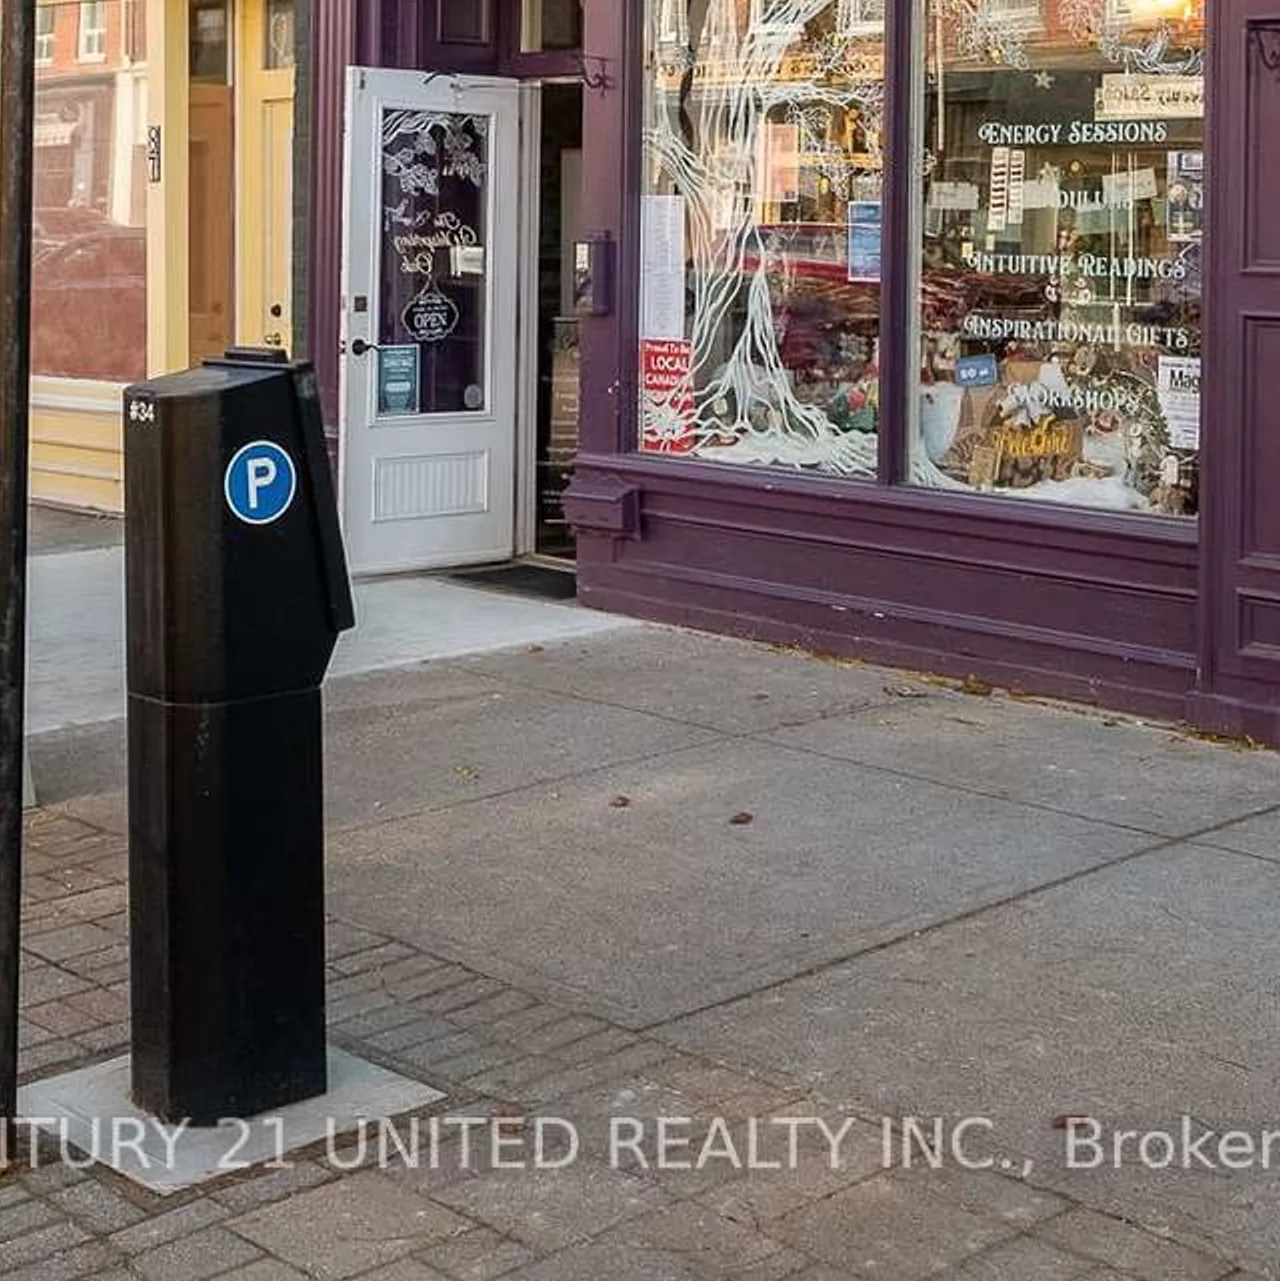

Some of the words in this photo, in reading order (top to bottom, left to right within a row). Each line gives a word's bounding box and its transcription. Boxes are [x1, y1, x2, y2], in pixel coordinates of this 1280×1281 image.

[978, 122, 1062, 145] ENERGY
[1068, 121, 1168, 144] SESSIONS
[967, 251, 1070, 276] INTUITIVE
[1078, 253, 1188, 280] READINGS
[963, 316, 1120, 344] INSPIRATIONAL
[1125, 322, 1189, 349] GIFTS
[128, 400, 155, 422] #34
[247, 457, 277, 509] P
